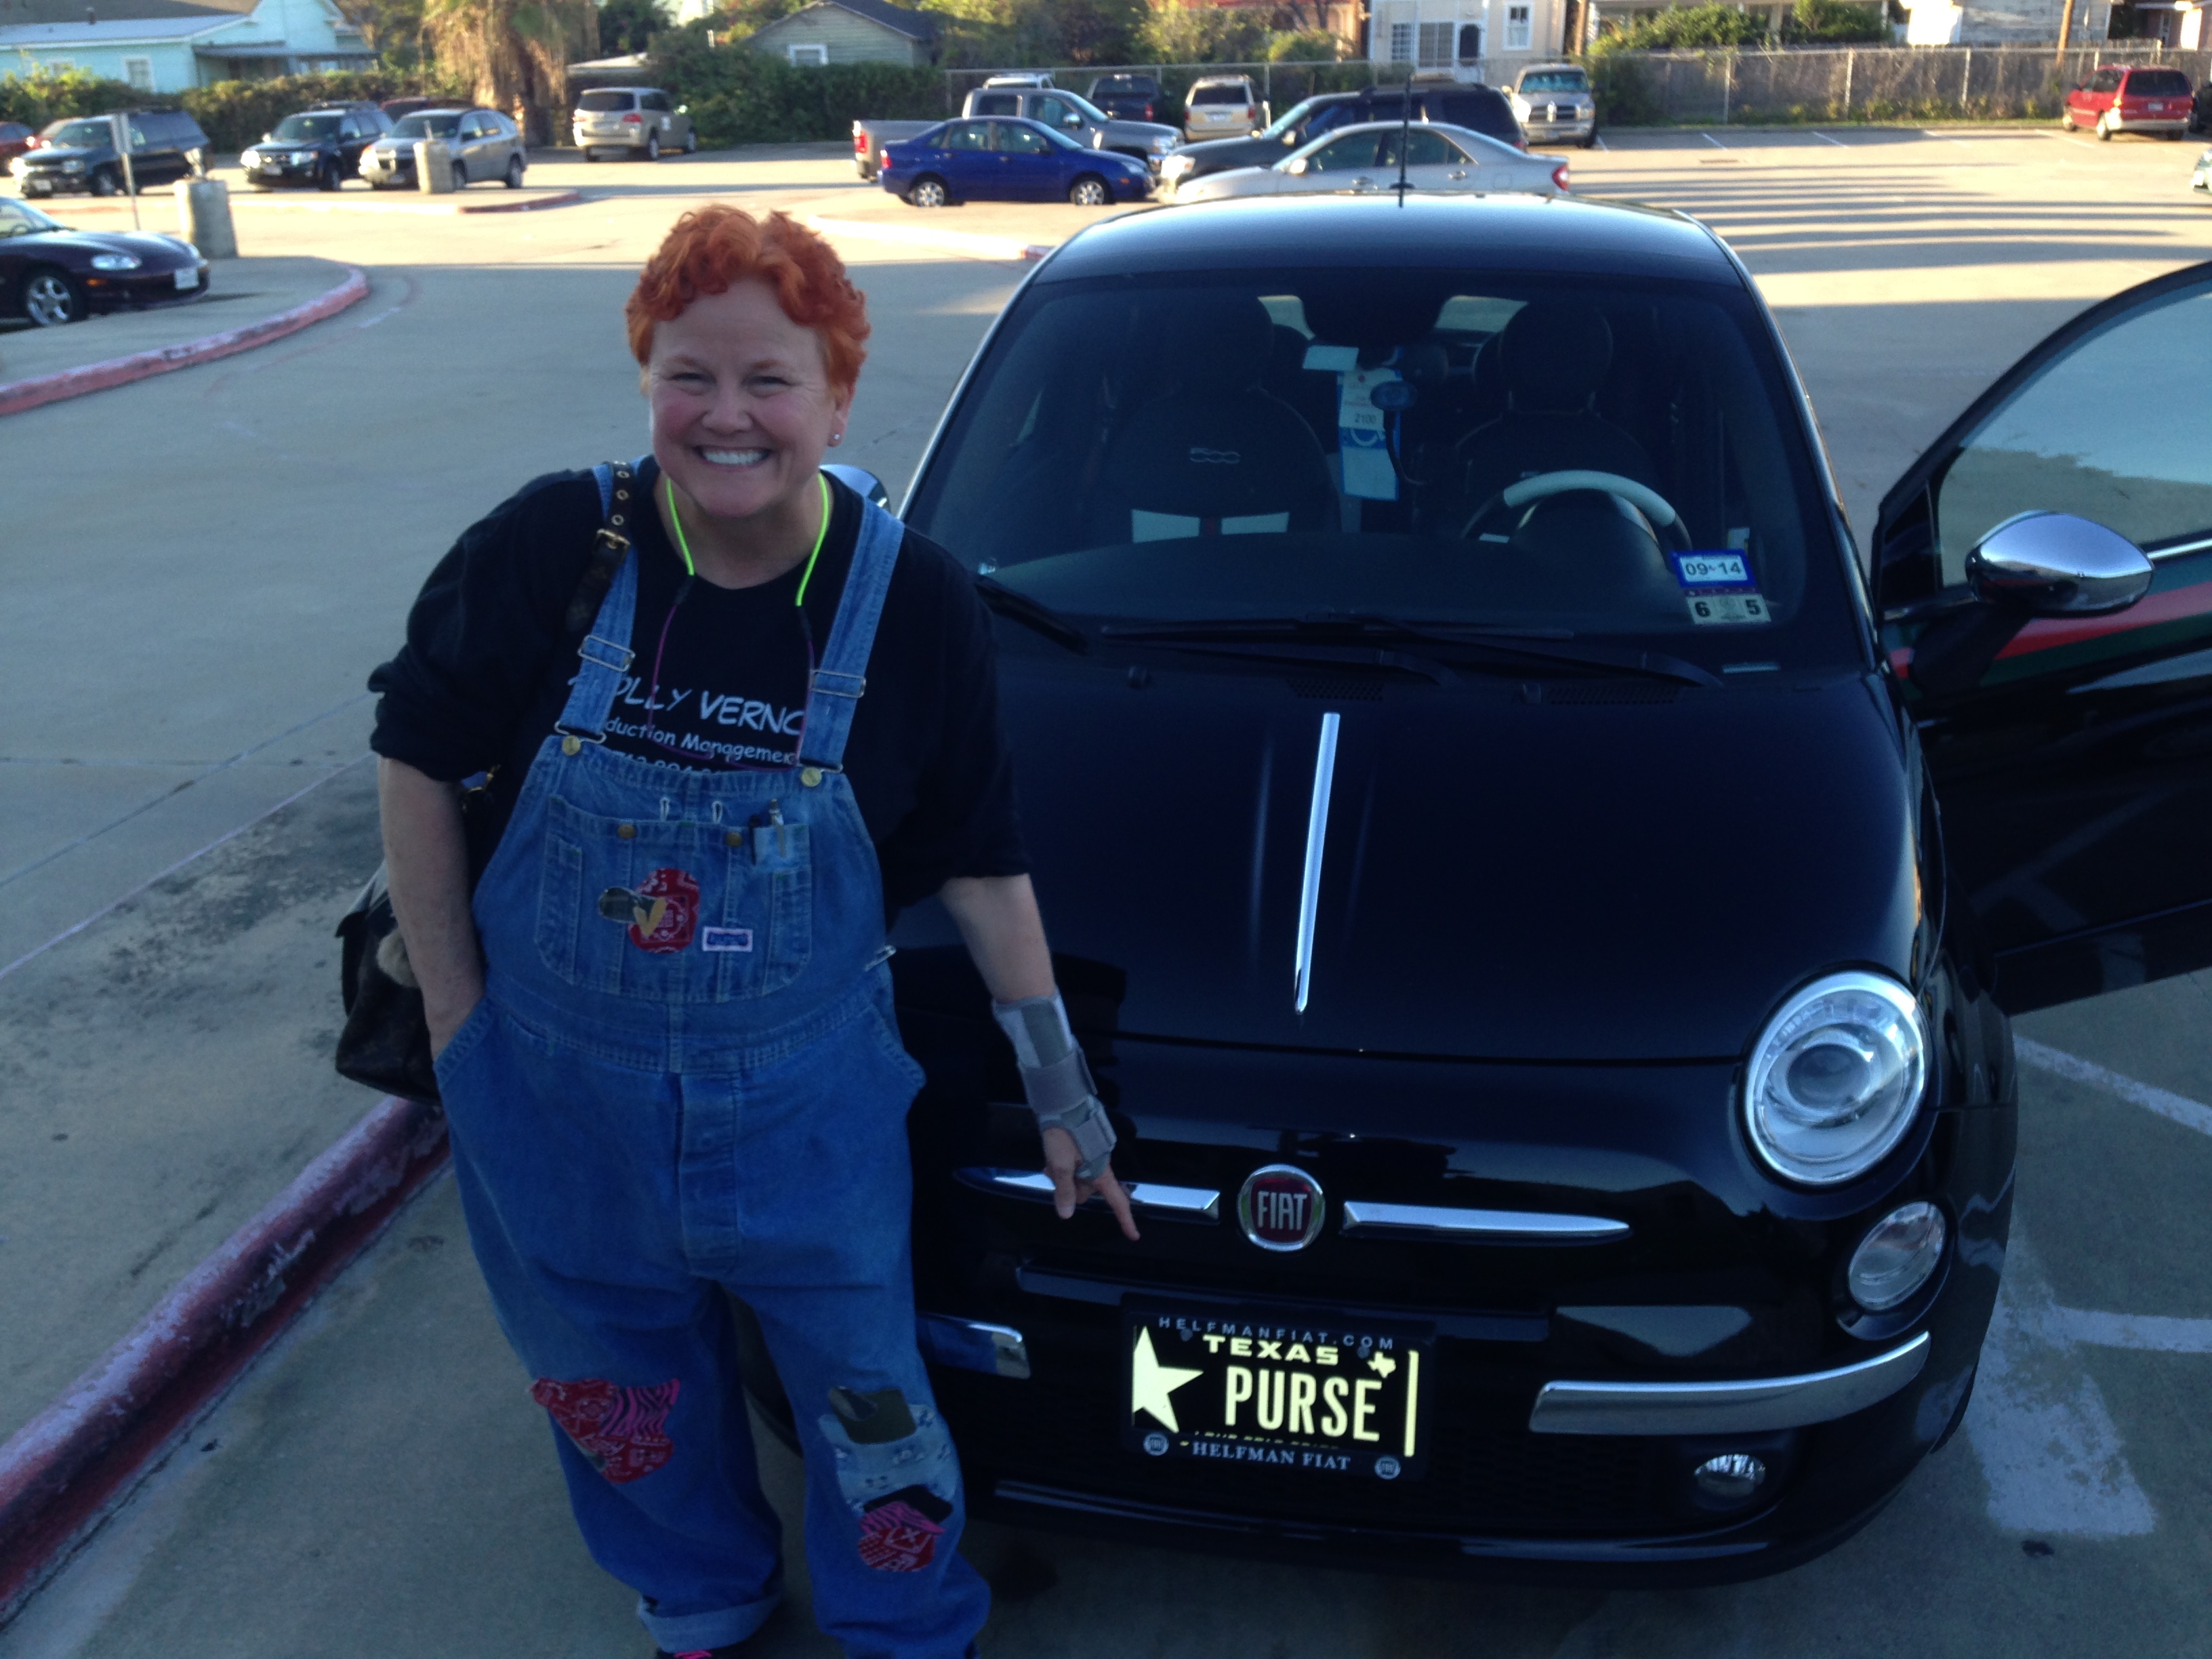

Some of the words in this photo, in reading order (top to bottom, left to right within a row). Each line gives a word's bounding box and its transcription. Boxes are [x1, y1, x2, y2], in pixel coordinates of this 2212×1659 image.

[1694, 600, 1712, 617] 6
[1745, 598, 1762, 615] 5
[1256, 1190, 1308, 1231] FIAT
[1202, 1334, 1339, 1366] TEXAS
[1225, 1366, 1382, 1442] PURSE
[1191, 1441, 1296, 1465] HELFMAN
[1302, 1450, 1352, 1471] FIAT
